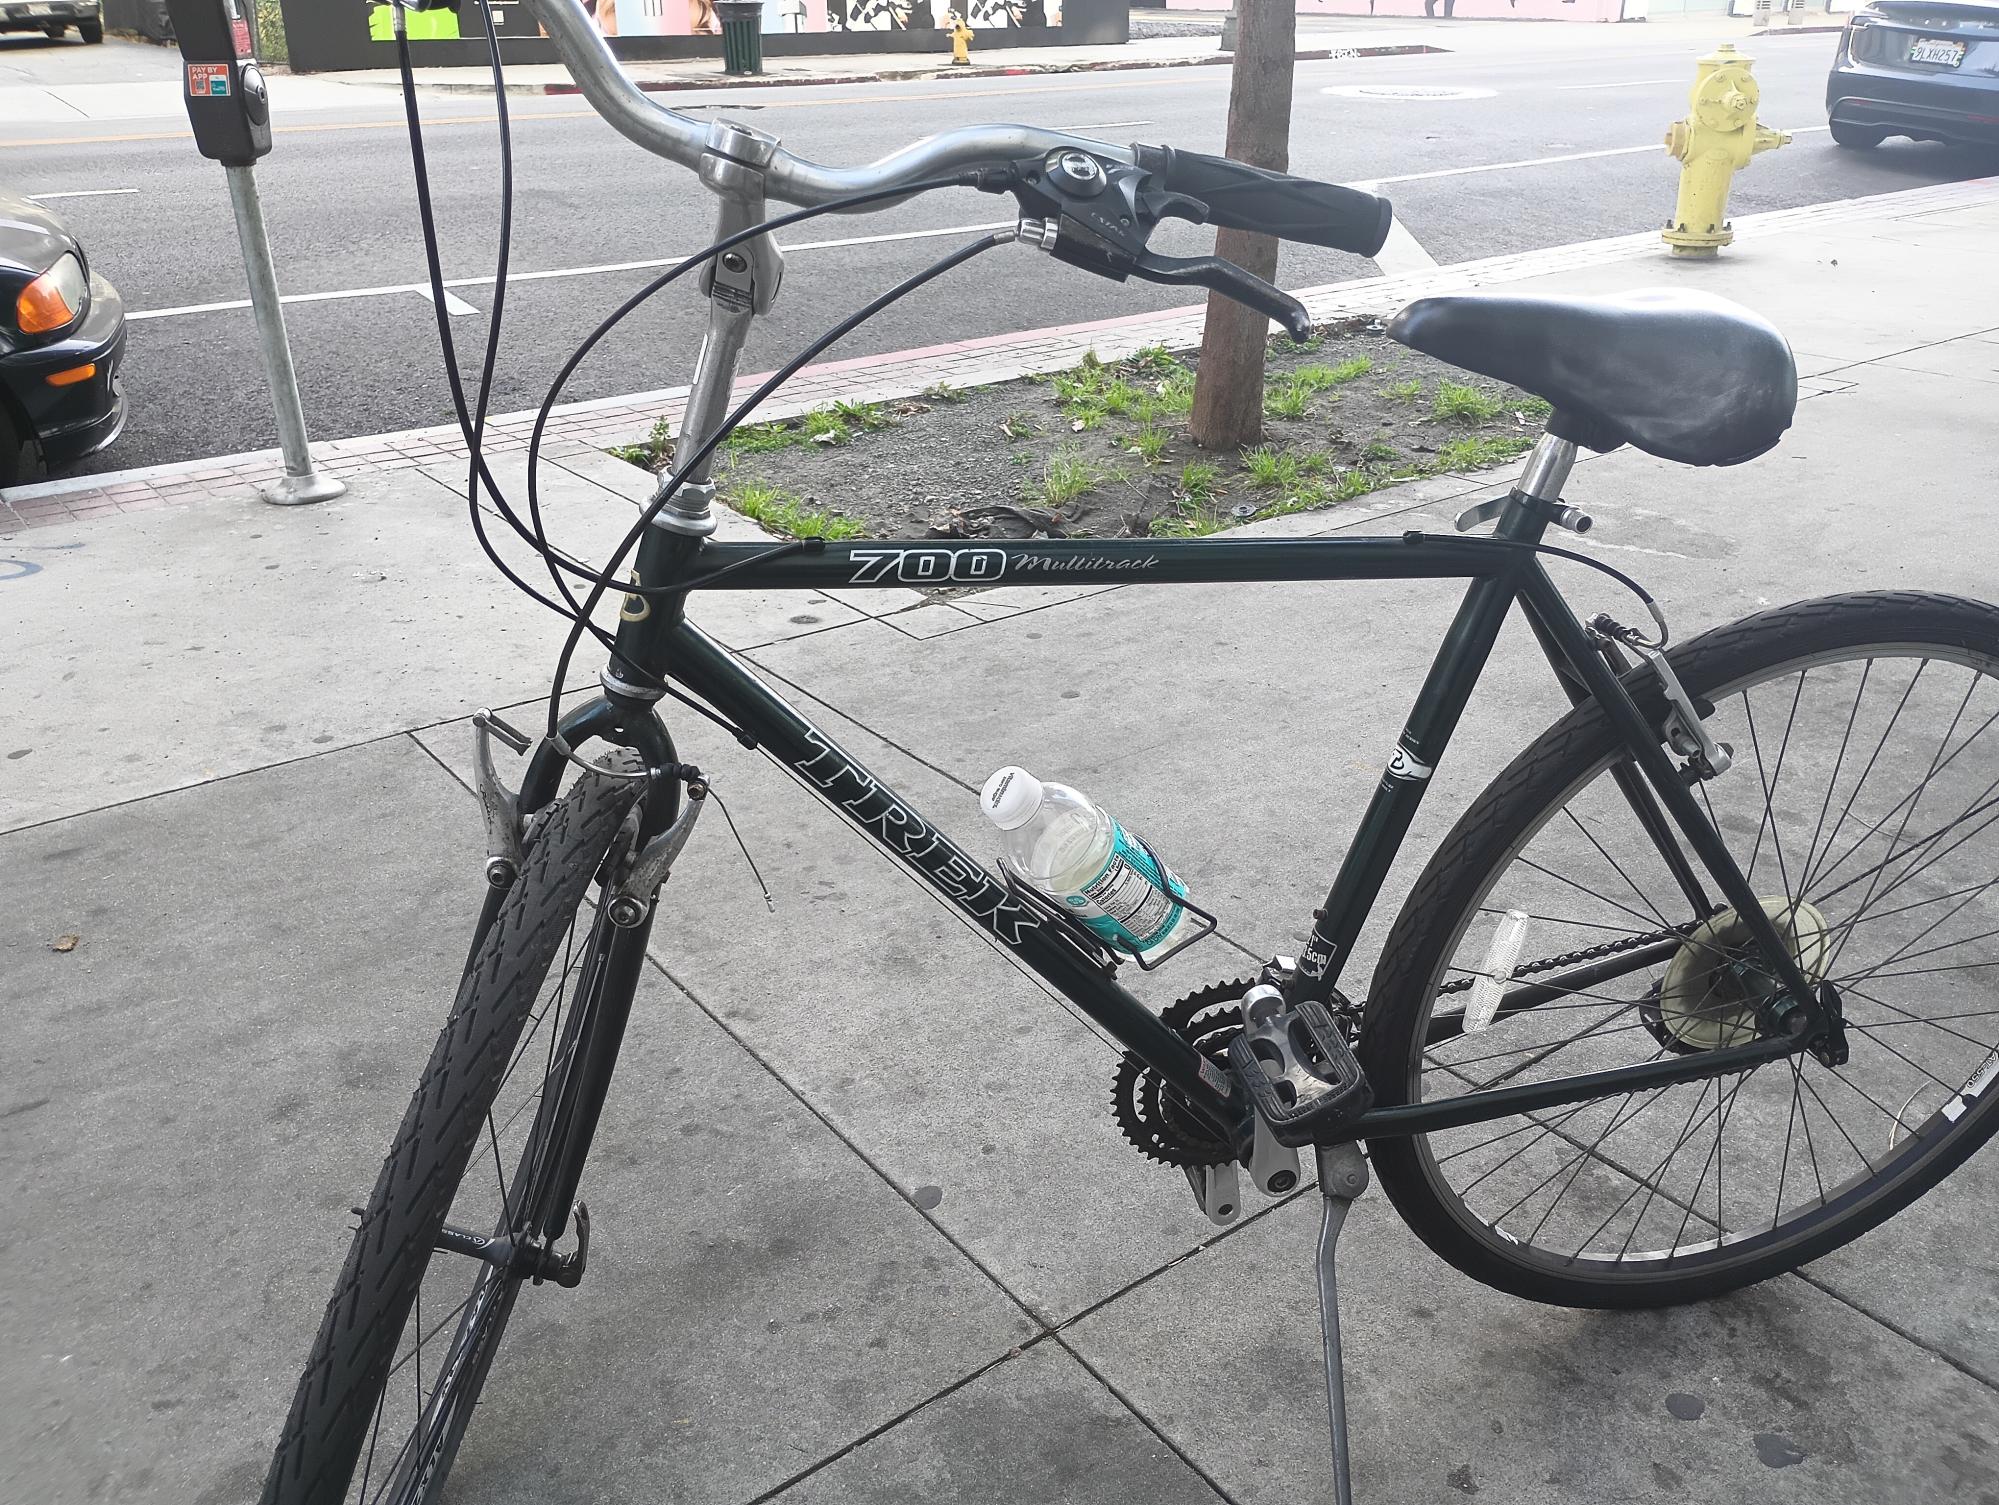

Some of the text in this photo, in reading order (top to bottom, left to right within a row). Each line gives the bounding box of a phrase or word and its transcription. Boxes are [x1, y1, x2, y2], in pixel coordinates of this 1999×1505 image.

[1915, 47, 1958, 62] 9LXH257
[849, 548, 1160, 583] 700 Multitrack
[794, 727, 1041, 945] TREK
[1085, 873, 1109, 895] Nutrition
[1108, 855, 1120, 873] Facts
[1097, 888, 1117, 905] Calories
